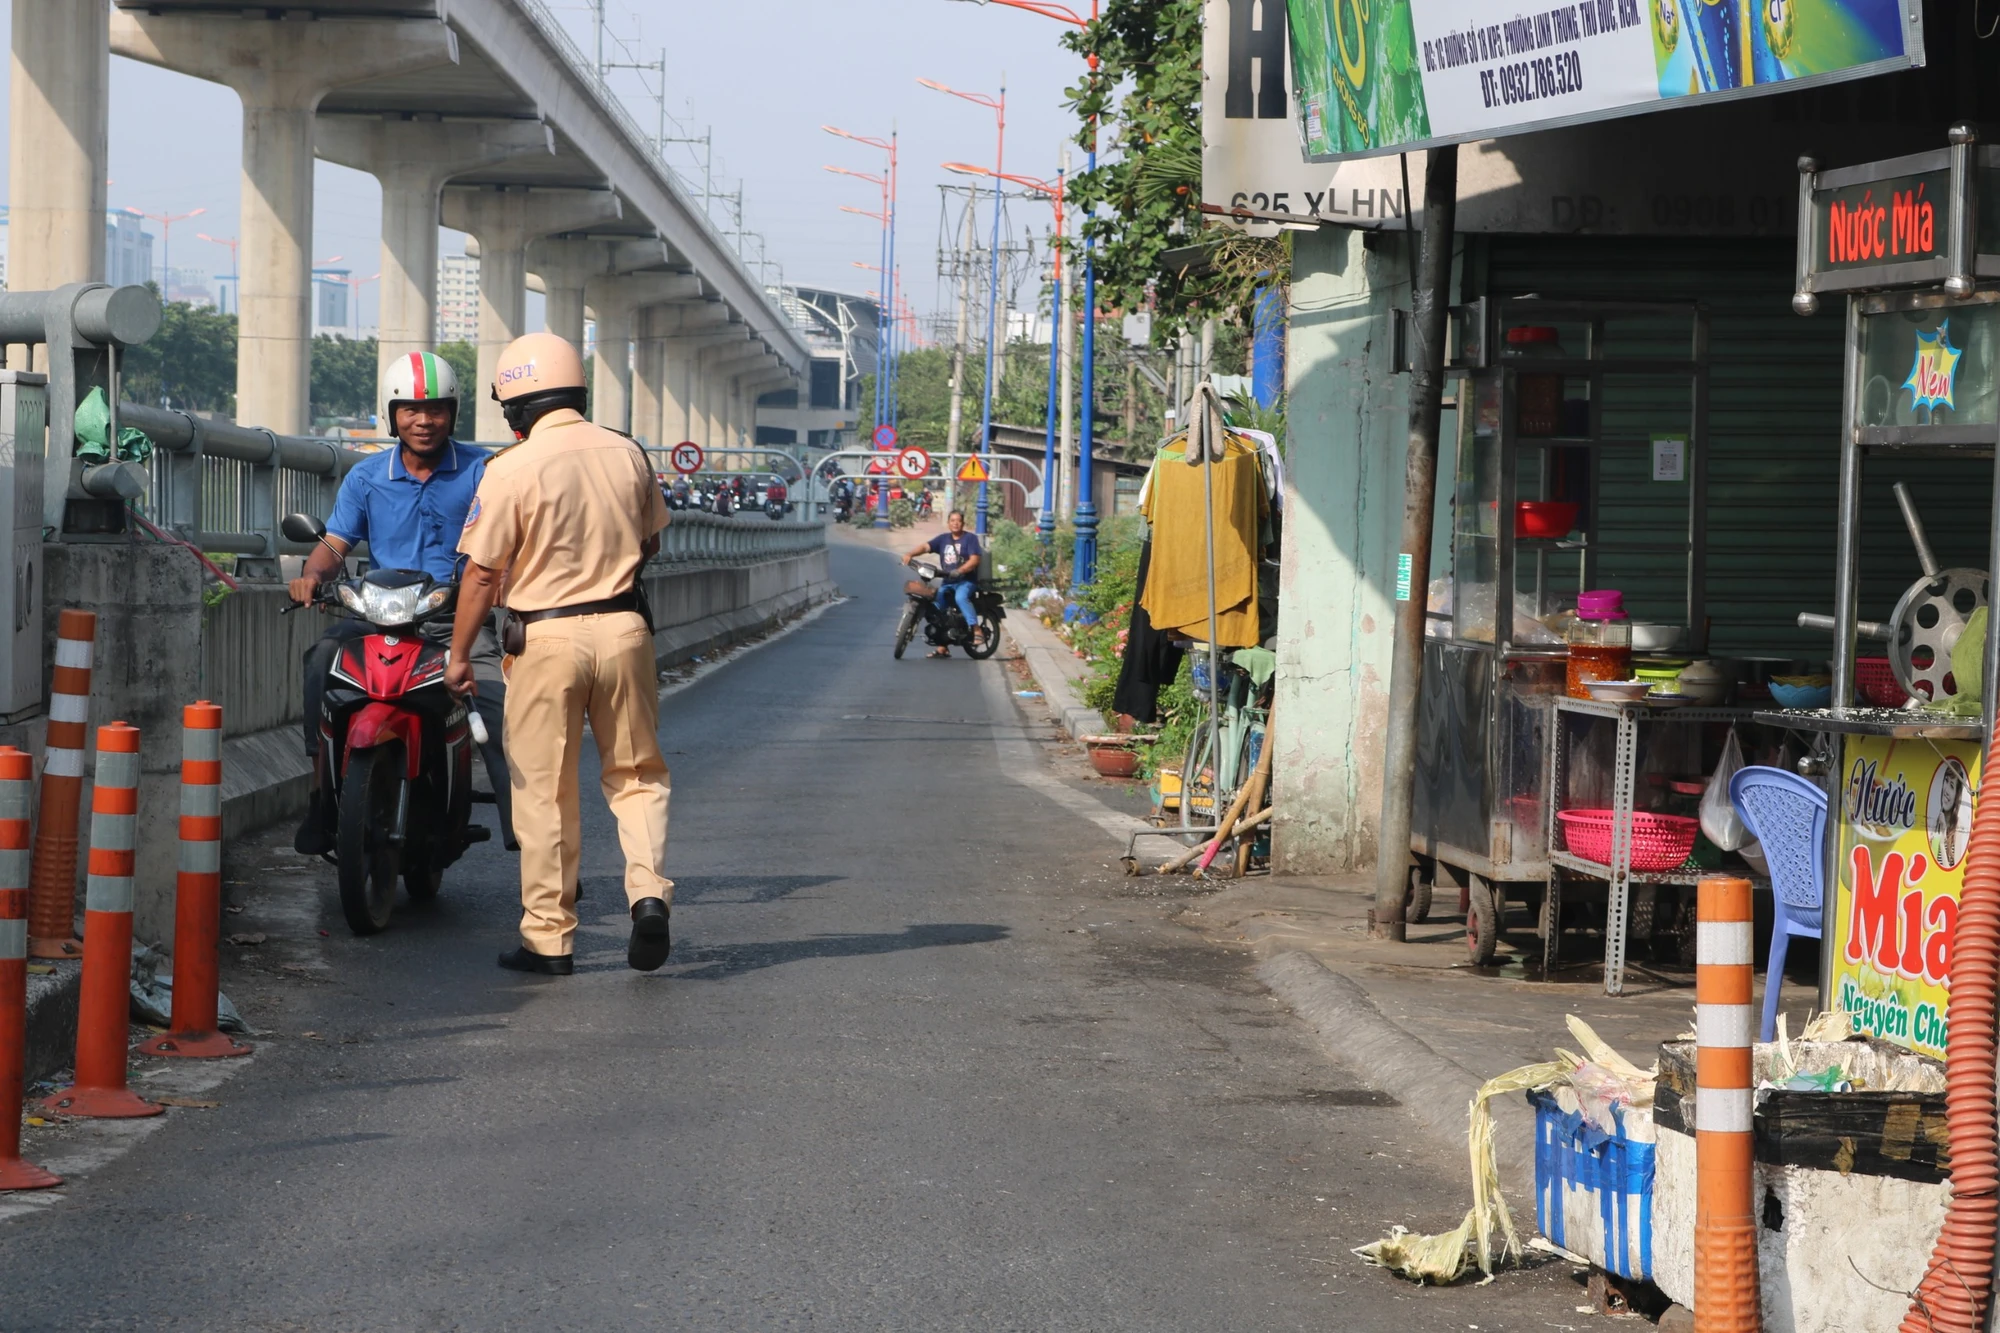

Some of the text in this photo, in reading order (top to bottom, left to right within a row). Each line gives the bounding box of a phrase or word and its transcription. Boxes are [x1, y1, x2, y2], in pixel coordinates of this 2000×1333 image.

[1478, 28, 1488, 61] 18
[1534, 12, 1553, 49] LINH
[1551, 5, 1582, 45] TRUNG,
[1480, 50, 1583, 108] ĐT: 0932.786.520
[1304, 188, 1402, 218] XLHN
[1829, 182, 1933, 263] Nước Mía
[499, 364, 535, 386] CSGT
[1915, 354, 1951, 399] New
[1850, 757, 1916, 829] Nước
[1845, 845, 1959, 984] Mía
[1843, 983, 1908, 1038] Nguyên
